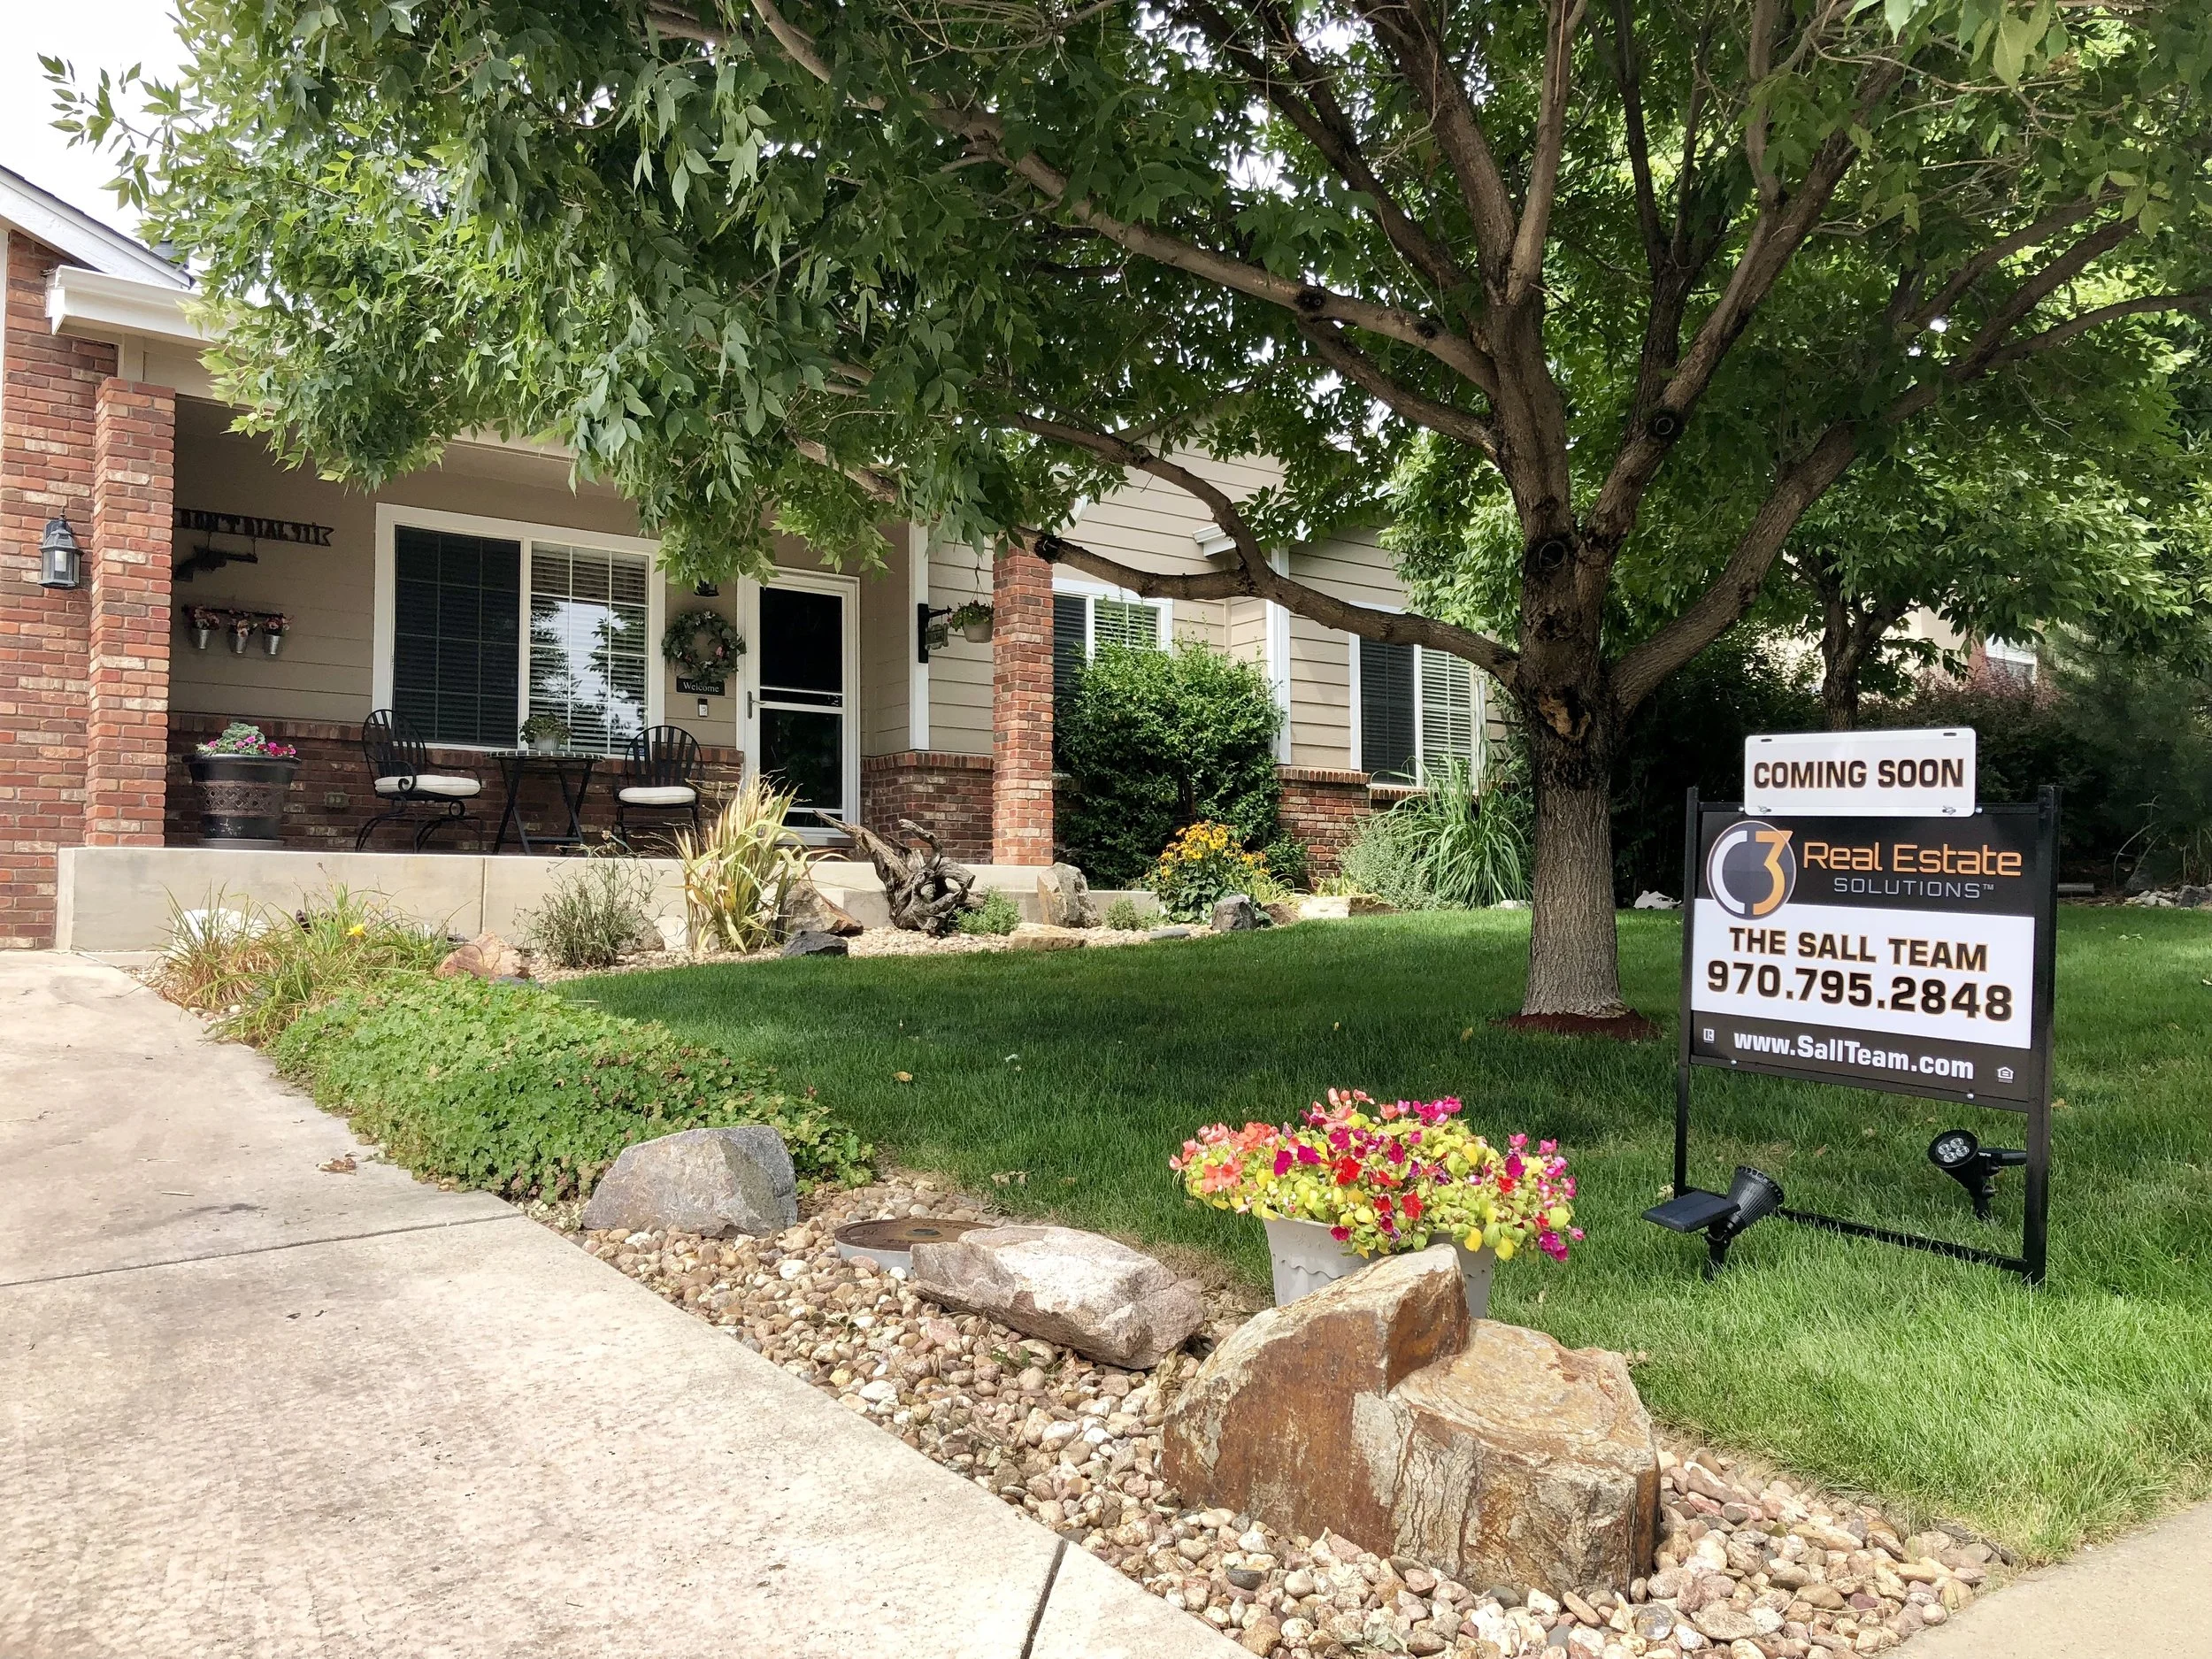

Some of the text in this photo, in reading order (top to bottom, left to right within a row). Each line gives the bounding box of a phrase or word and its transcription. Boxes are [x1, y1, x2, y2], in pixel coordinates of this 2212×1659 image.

[683, 681, 719, 692] Welcome
[1754, 758, 1964, 788] COMING SOON
[1803, 841, 2023, 877] Real Estate
[1730, 926, 1988, 972] THE SALL TEAM
[1707, 961, 2013, 1021] 970.795.2848
[1734, 1031, 1974, 1079] www.SallTeam.com
